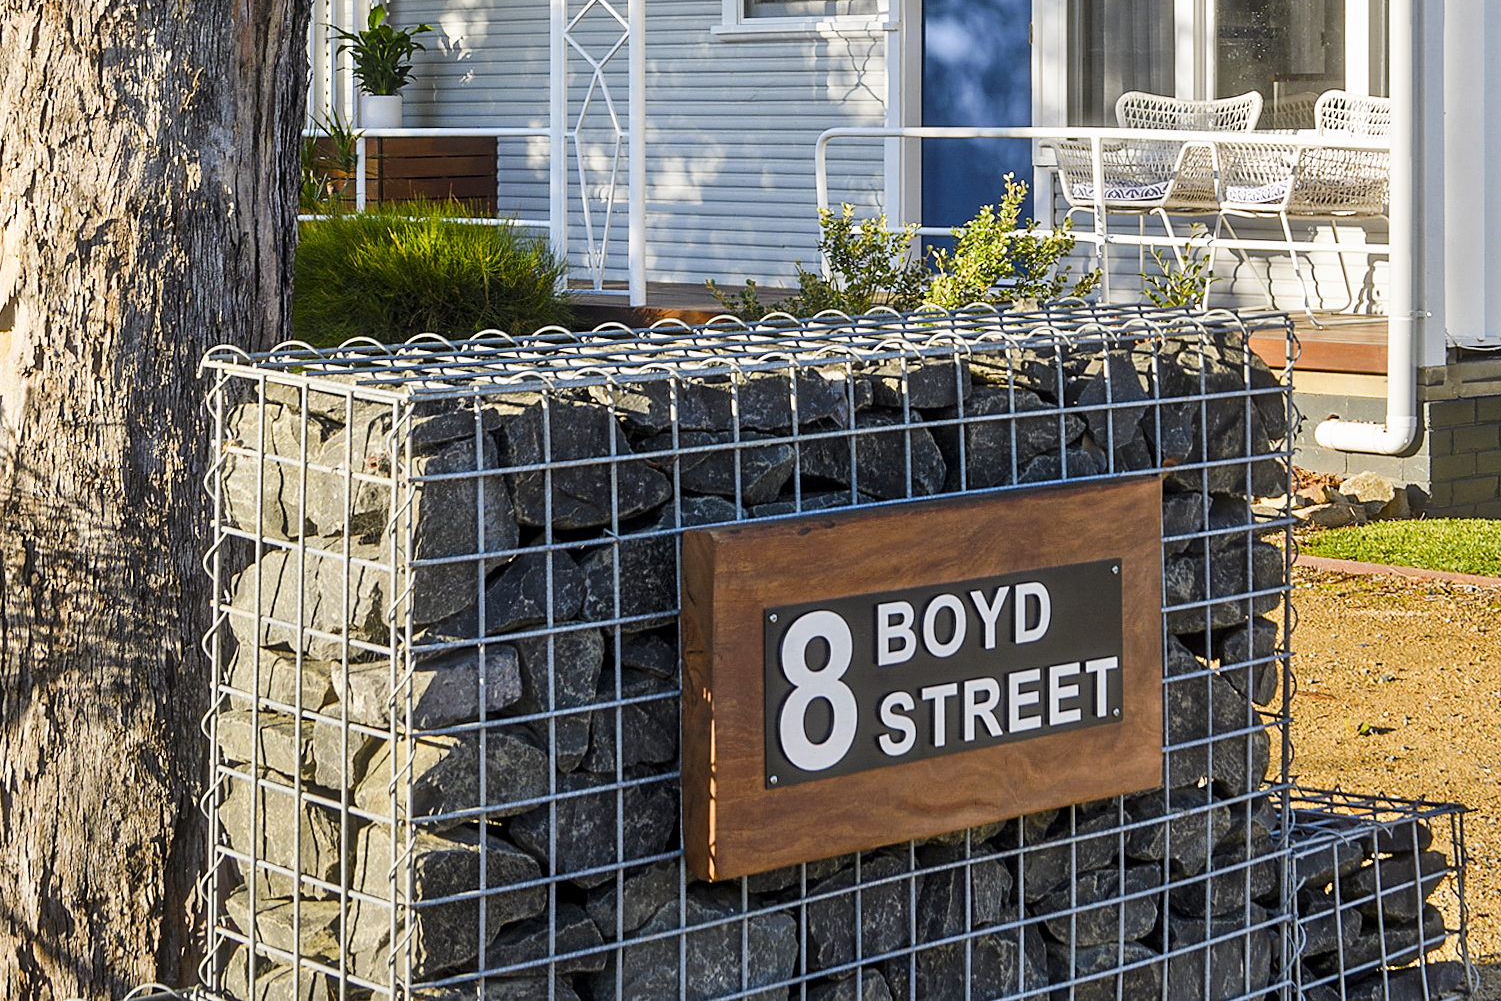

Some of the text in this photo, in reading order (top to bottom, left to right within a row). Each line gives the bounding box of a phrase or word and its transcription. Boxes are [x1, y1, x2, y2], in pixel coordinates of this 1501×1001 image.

[877, 581, 1052, 668] BOYD
[779, 610, 858, 771] 8
[878, 656, 1119, 756] STREET
